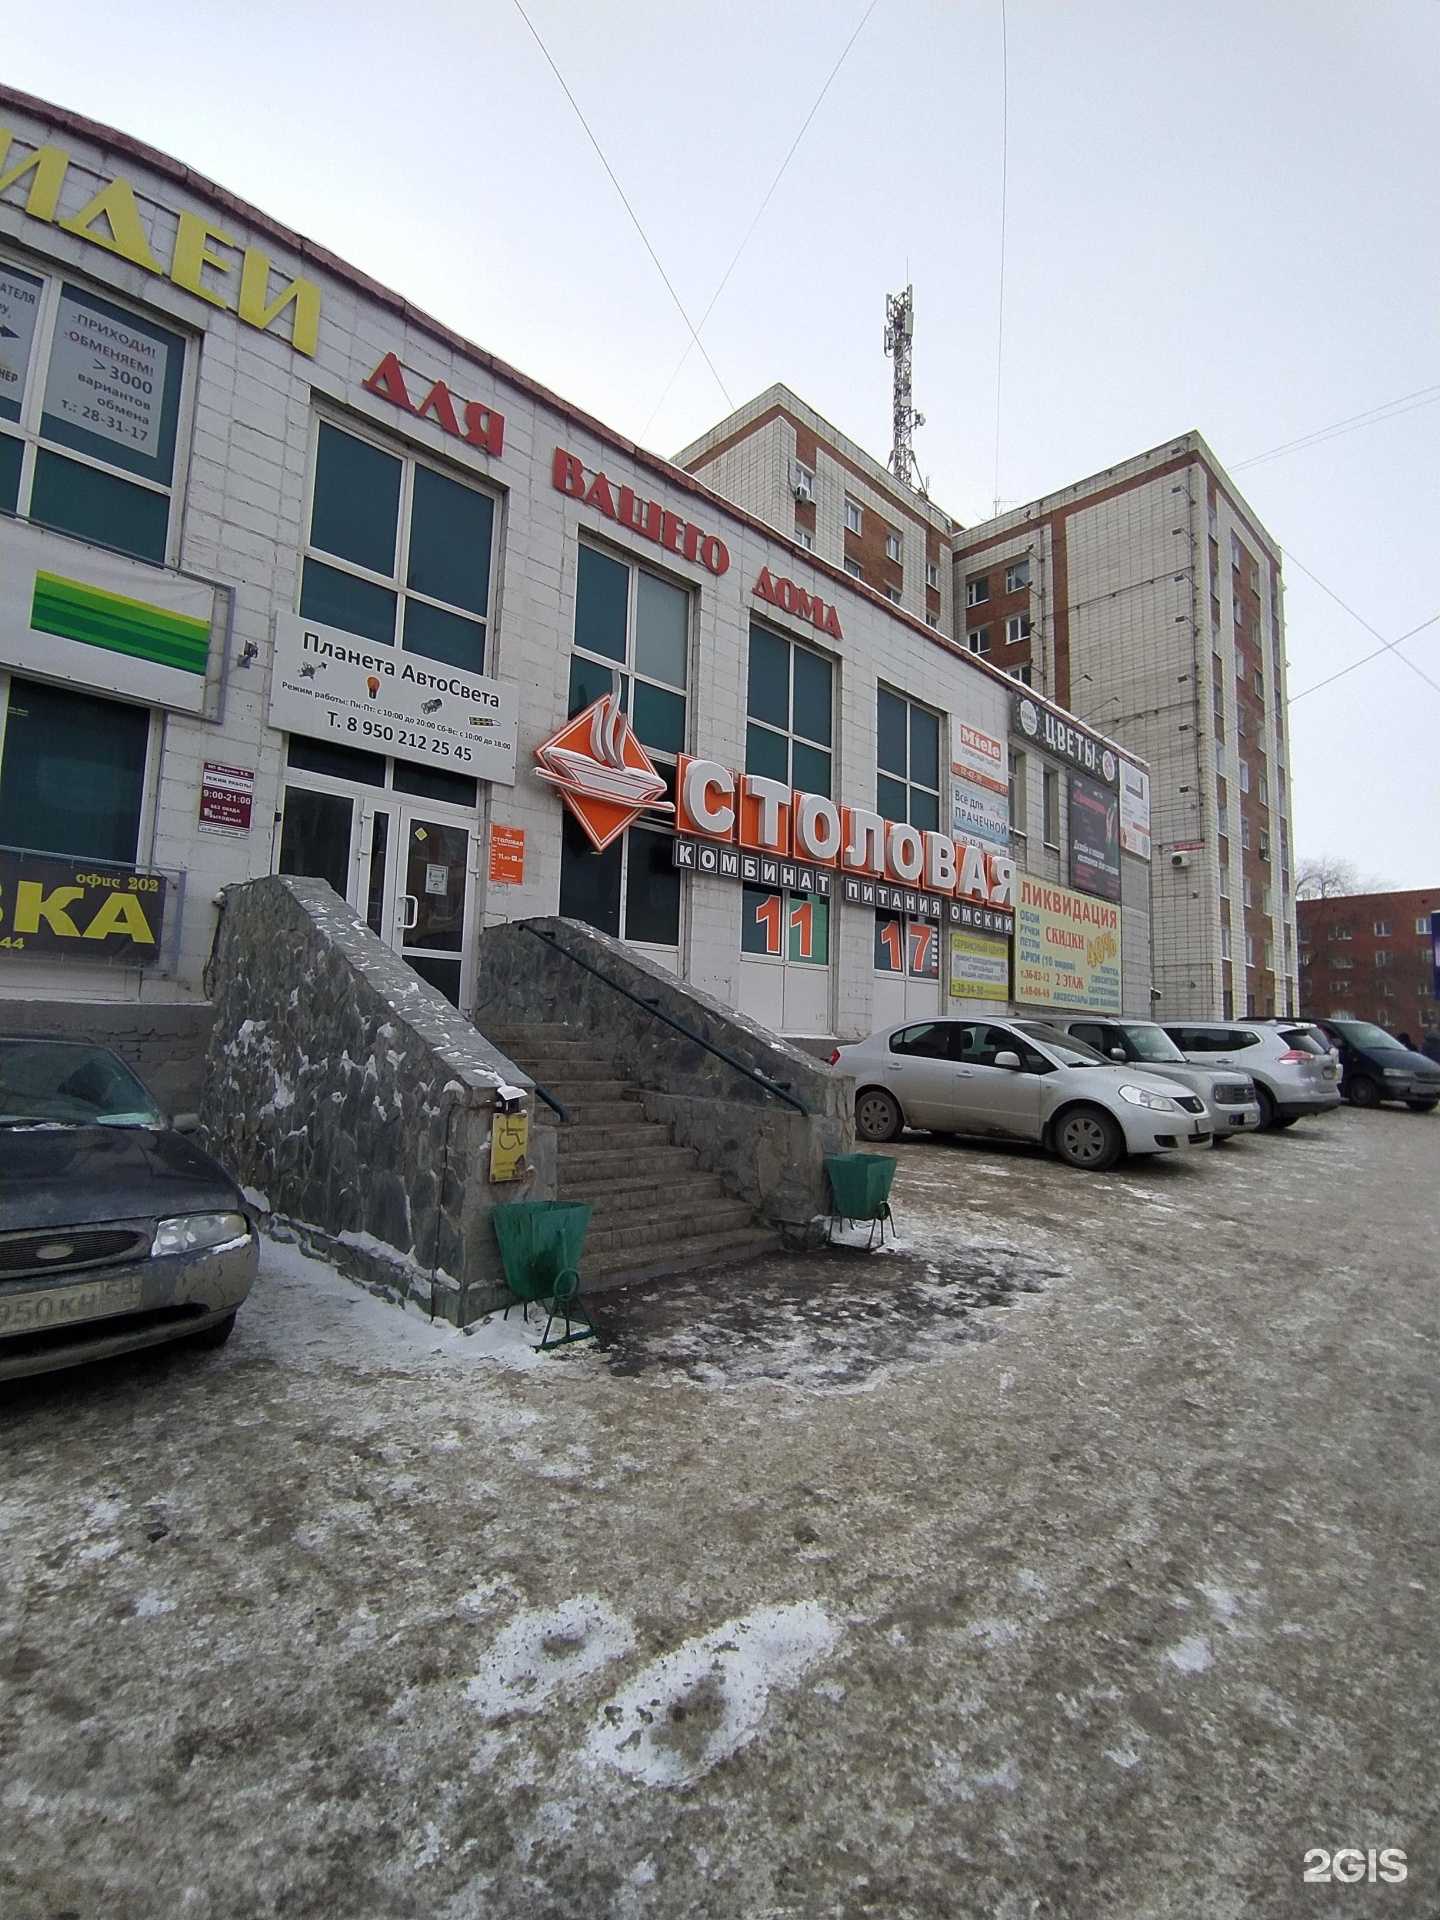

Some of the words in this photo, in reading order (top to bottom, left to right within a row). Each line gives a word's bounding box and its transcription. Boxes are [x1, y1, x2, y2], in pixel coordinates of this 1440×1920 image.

[78, 373, 151, 411] вариантов
[110, 365, 153, 395] 3000
[82, 406, 148, 442] 28-31-17
[97, 398, 149, 425] обмена
[361, 351, 505, 457] ДЛЯ
[552, 446, 729, 577] ВАШЕГО
[751, 566, 844, 641] ДОМА
[303, 631, 395, 676] Планета
[401, 663, 500, 708] АвтоСвета
[282, 681, 313, 696] Режим
[314, 690, 348, 706] работы:
[350, 700, 376, 713] Пн-Пт:
[383, 708, 404, 721] 10:00
[405, 716, 415, 726] до
[465, 731, 483, 743] 10:00
[327, 711, 342, 728] Т.
[347, 717, 358, 732] 8
[362, 721, 394, 742] 950
[398, 730, 427, 751] 212
[431, 739, 450, 756] 25
[454, 745, 472, 762] 45
[961, 727, 1000, 759] Miele
[1045, 713, 1095, 770] ЦВЕТЫ
[203, 789, 251, 805] 9:00-21:00
[682, 759, 1017, 904] СТОЛОВАЯ
[955, 807, 1007, 836] ПРАЧЕЧНОЙ
[75, 873, 121, 888] офис
[128, 876, 160, 893] 202
[677, 843, 830, 894] КОМБИНАТ
[846, 880, 941, 916] ПИТАНИЯ
[951, 905, 1013, 932] ОМСКИЙ
[1021, 881, 1117, 929] ЛИКВИДАЦИЯ
[1045, 926, 1084, 950] СКИДКИ
[1055, 973, 1061, 986] 2
[1063, 975, 1084, 990] ЭТАЖ
